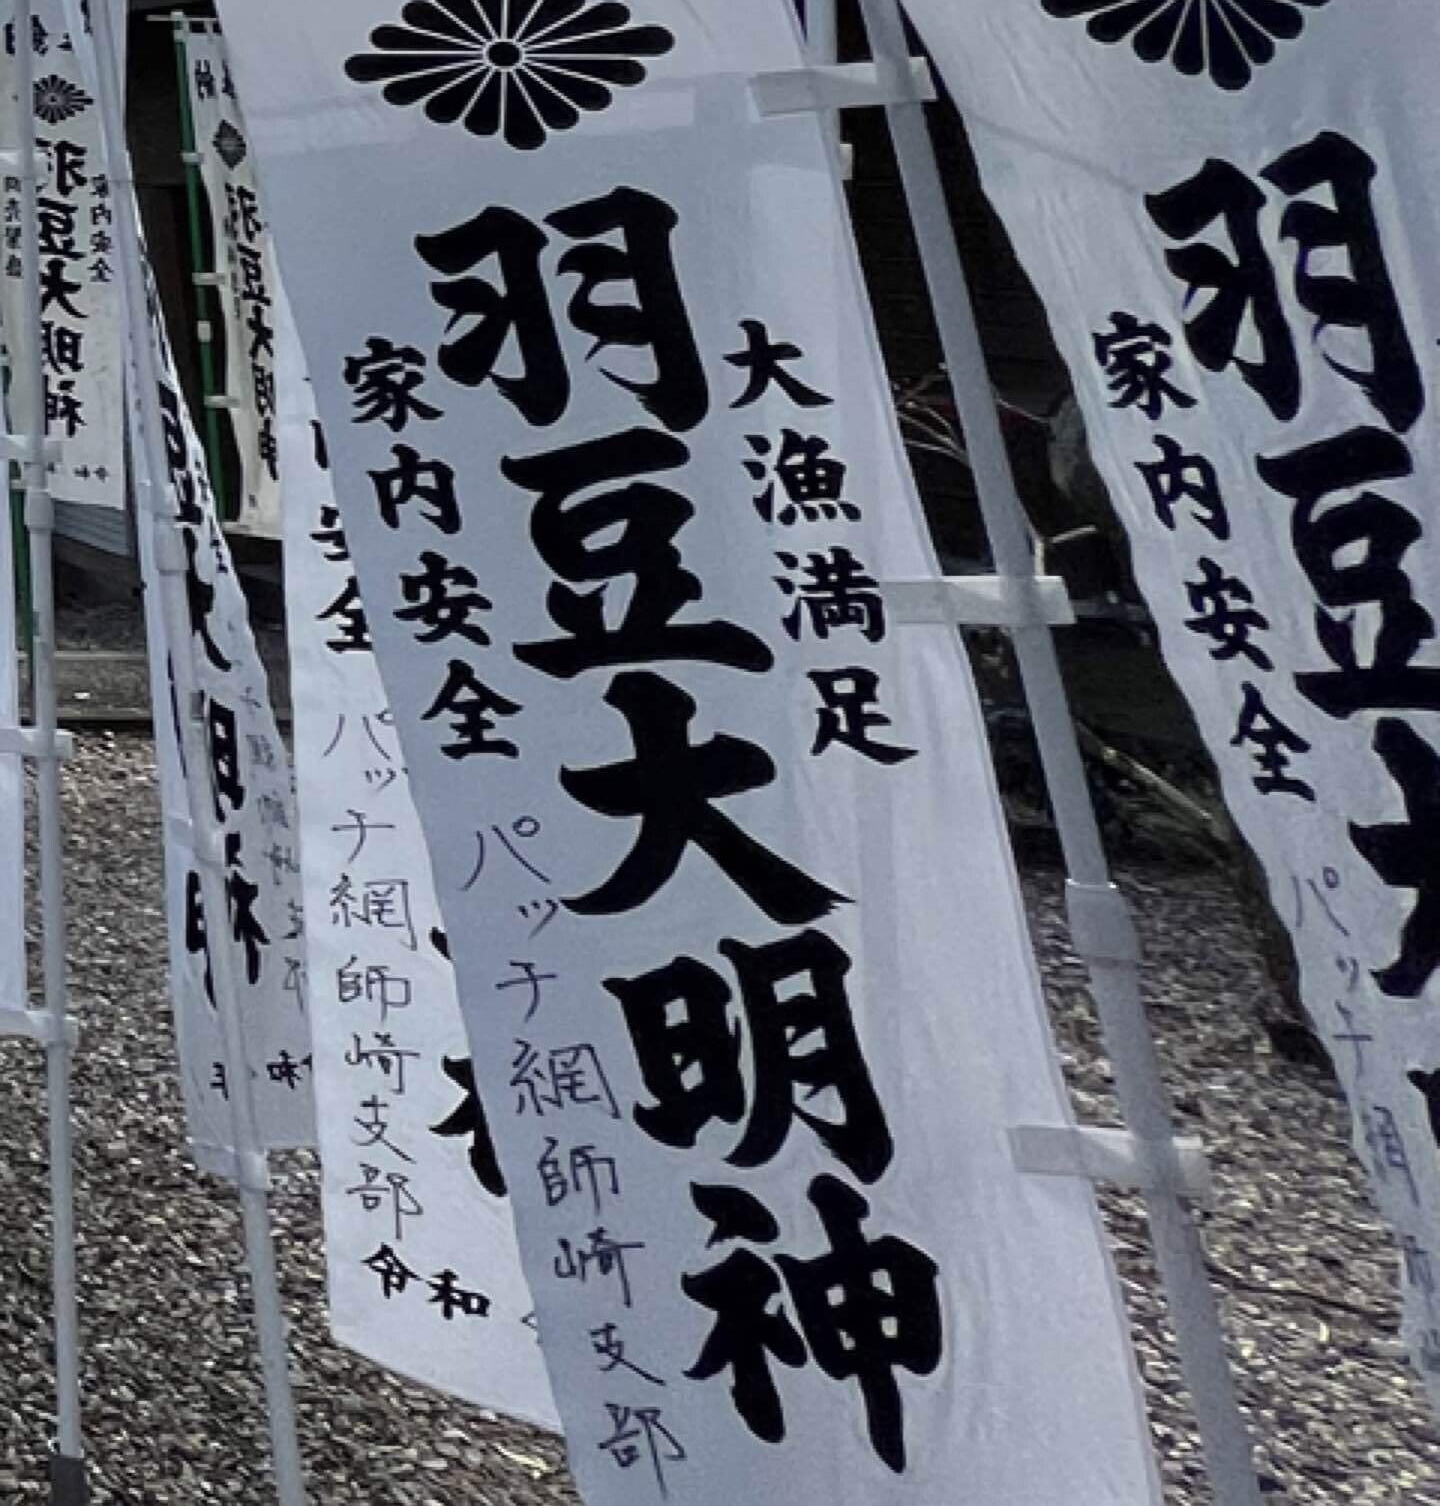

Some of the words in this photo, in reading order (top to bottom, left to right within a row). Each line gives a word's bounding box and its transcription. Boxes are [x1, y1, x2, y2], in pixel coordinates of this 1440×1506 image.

[342, 337, 523, 760] 家内安全
[722, 318, 919, 765] 大漁満足
[1092, 310, 1316, 802] 家内安全
[413, 184, 943, 1475] 羽豆大明神
